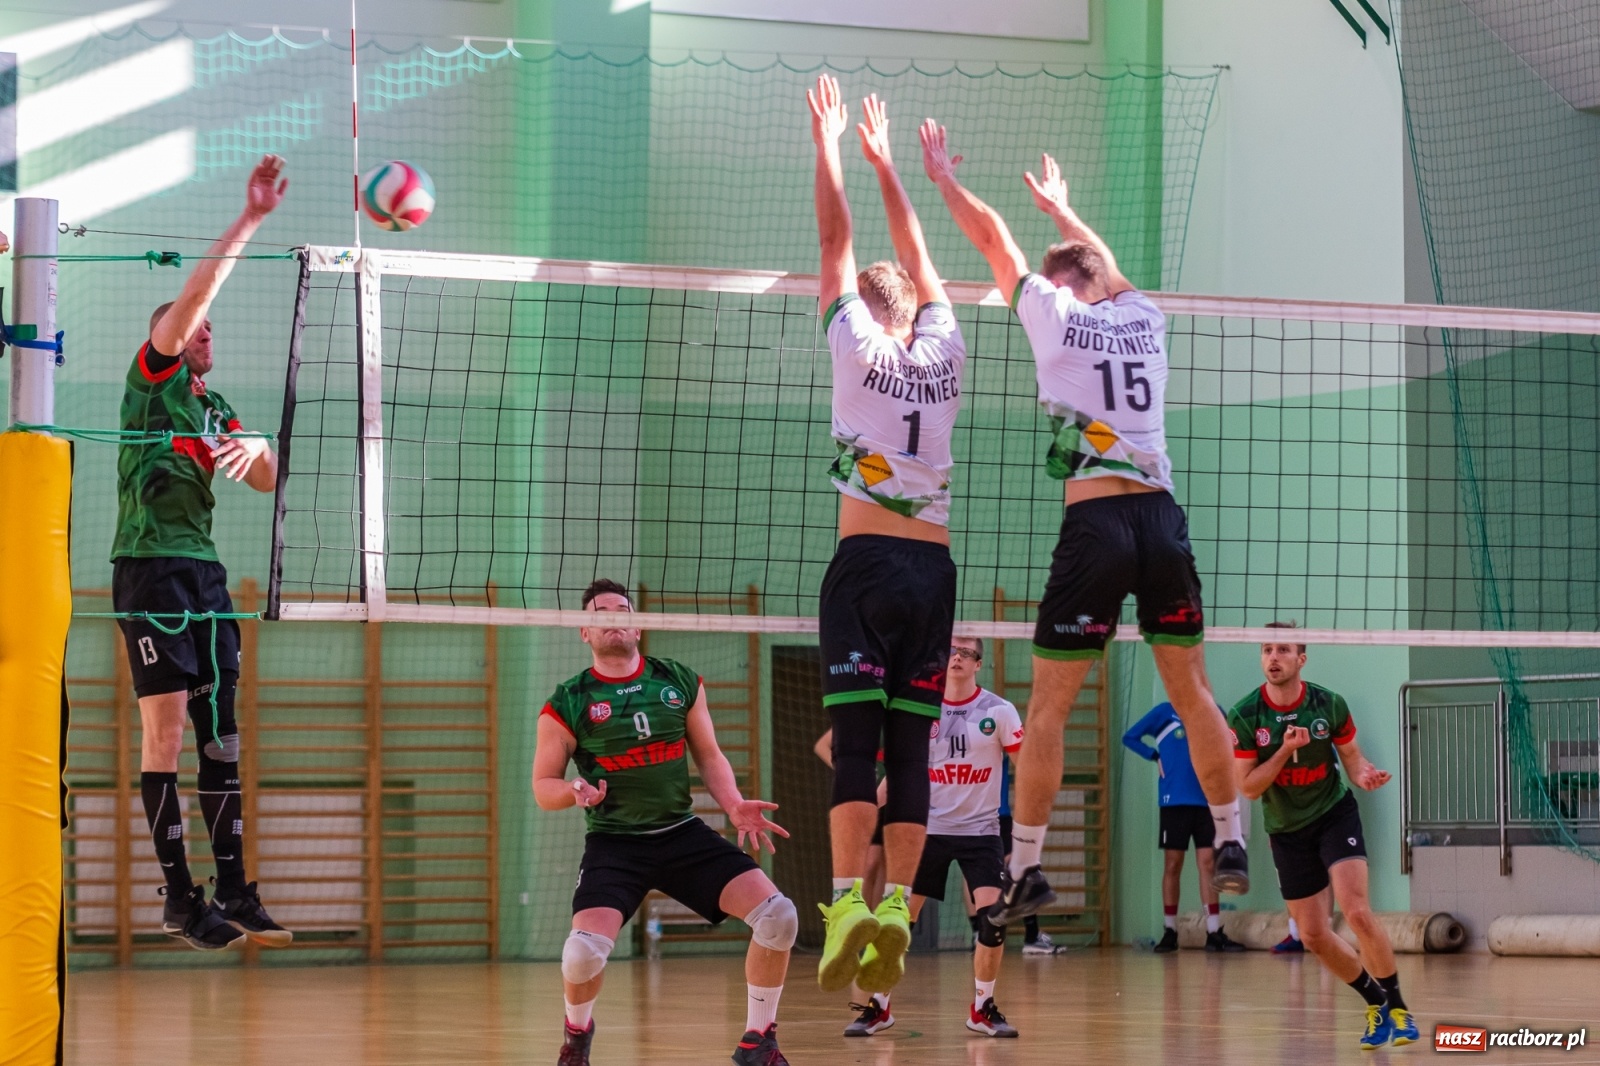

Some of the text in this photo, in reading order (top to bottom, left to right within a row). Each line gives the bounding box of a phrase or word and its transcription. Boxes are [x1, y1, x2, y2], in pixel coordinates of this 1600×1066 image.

[1068, 311, 1098, 330] KLUB
[1062, 327, 1160, 356] RUDZINIEC
[863, 368, 959, 405] RUDZINIEC
[1093, 359, 1152, 412] 15
[903, 410, 921, 456] 1
[138, 636, 159, 666] 13
[829, 663, 854, 676] MIAMI
[624, 684, 642, 694] VIGO
[633, 711, 652, 740] 9
[949, 734, 966, 758] 14
[1163, 794, 1171, 804] 17
